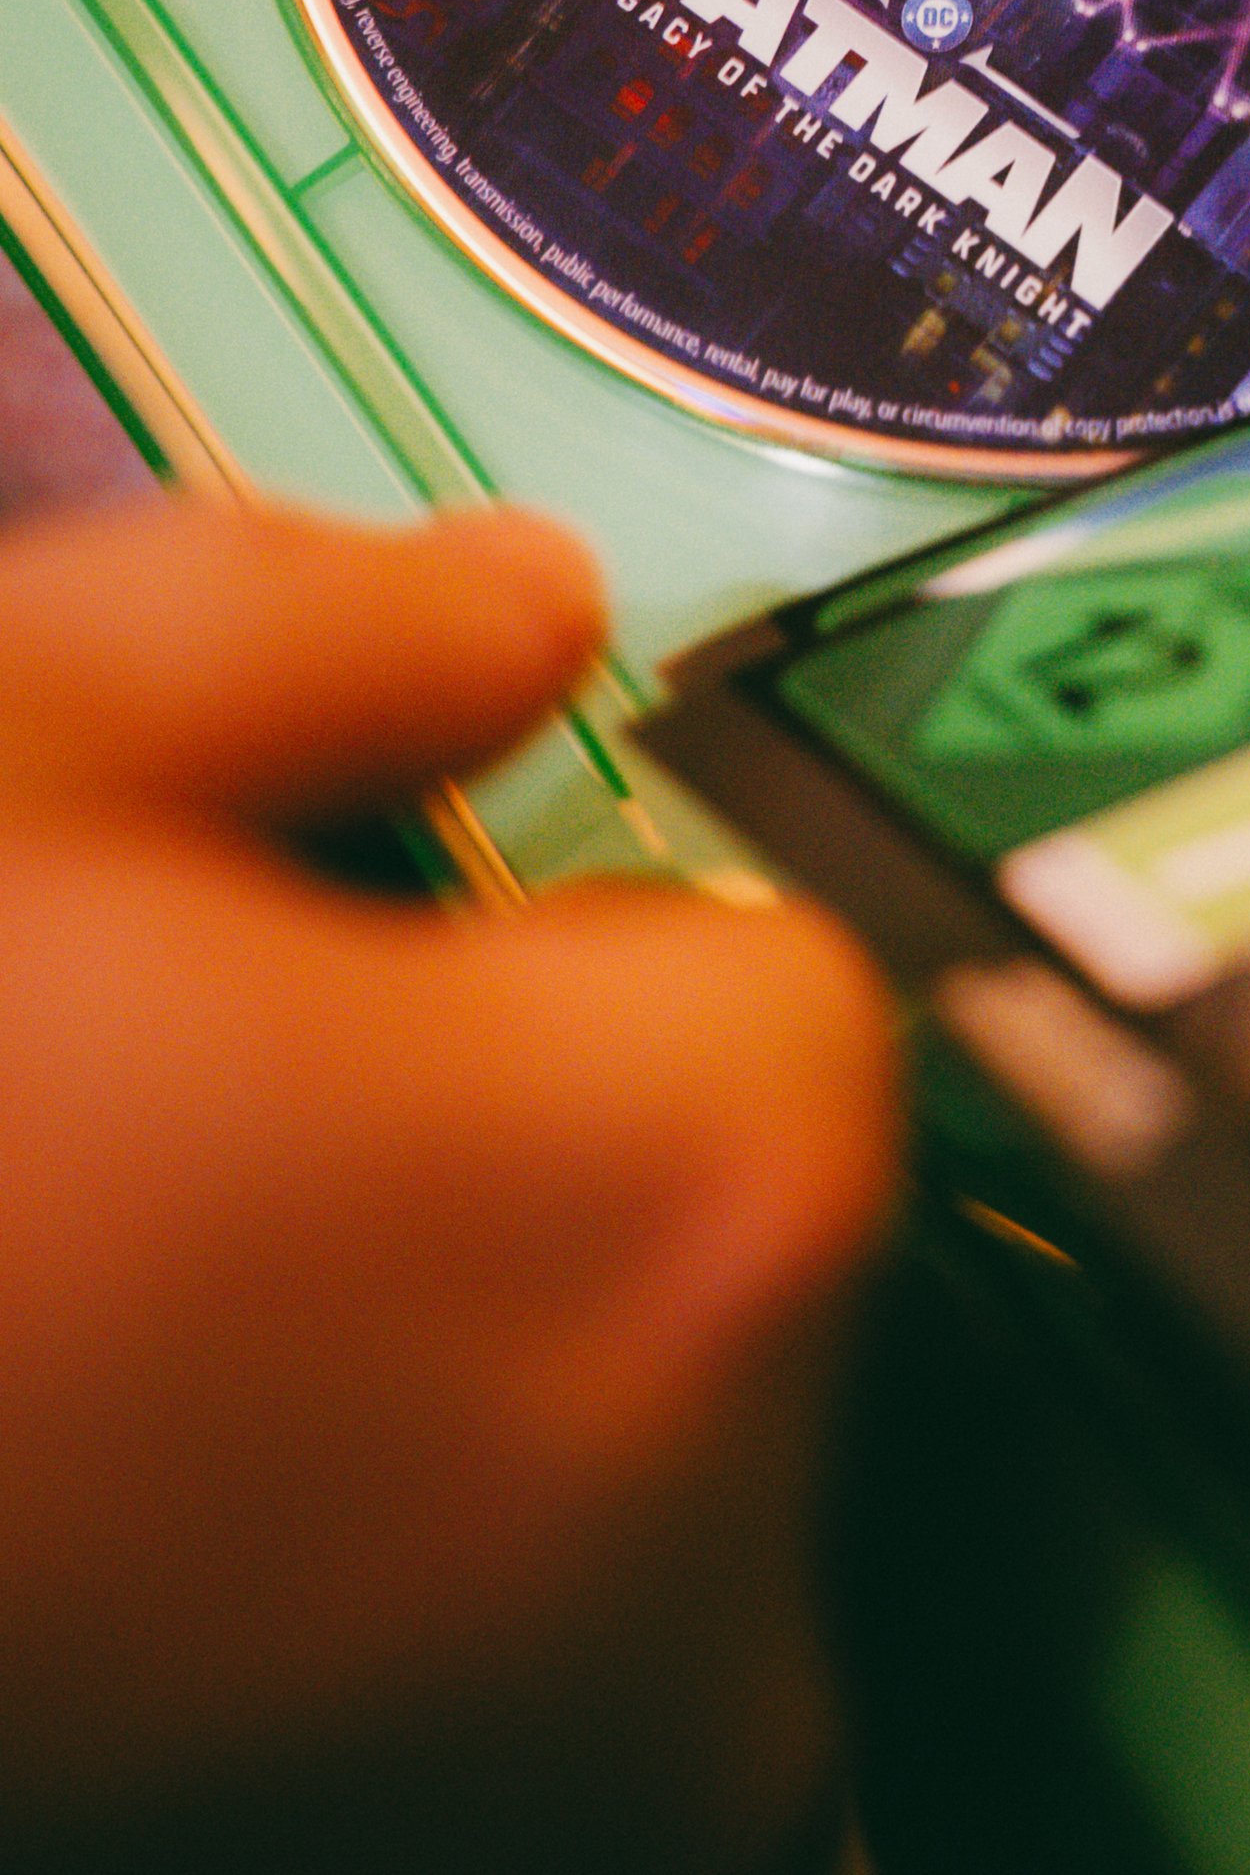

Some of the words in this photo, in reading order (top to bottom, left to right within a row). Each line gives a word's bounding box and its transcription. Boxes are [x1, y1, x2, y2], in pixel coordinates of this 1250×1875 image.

[354, 6, 395, 68] reverse
[387, 65, 459, 165] engineering,
[455, 155, 546, 254] transmission,
[540, 242, 595, 290] public
[589, 279, 701, 358] performance,
[704, 342, 760, 383] rental,
[760, 366, 798, 399] pay
[800, 374, 829, 405] for
[878, 398, 899, 421] or
[903, 400, 1036, 438] circumvention
[717, 56, 768, 99] OF
[773, 94, 845, 159] THE
[847, 152, 947, 235] DARK
[951, 227, 1093, 340] KNIGHT
